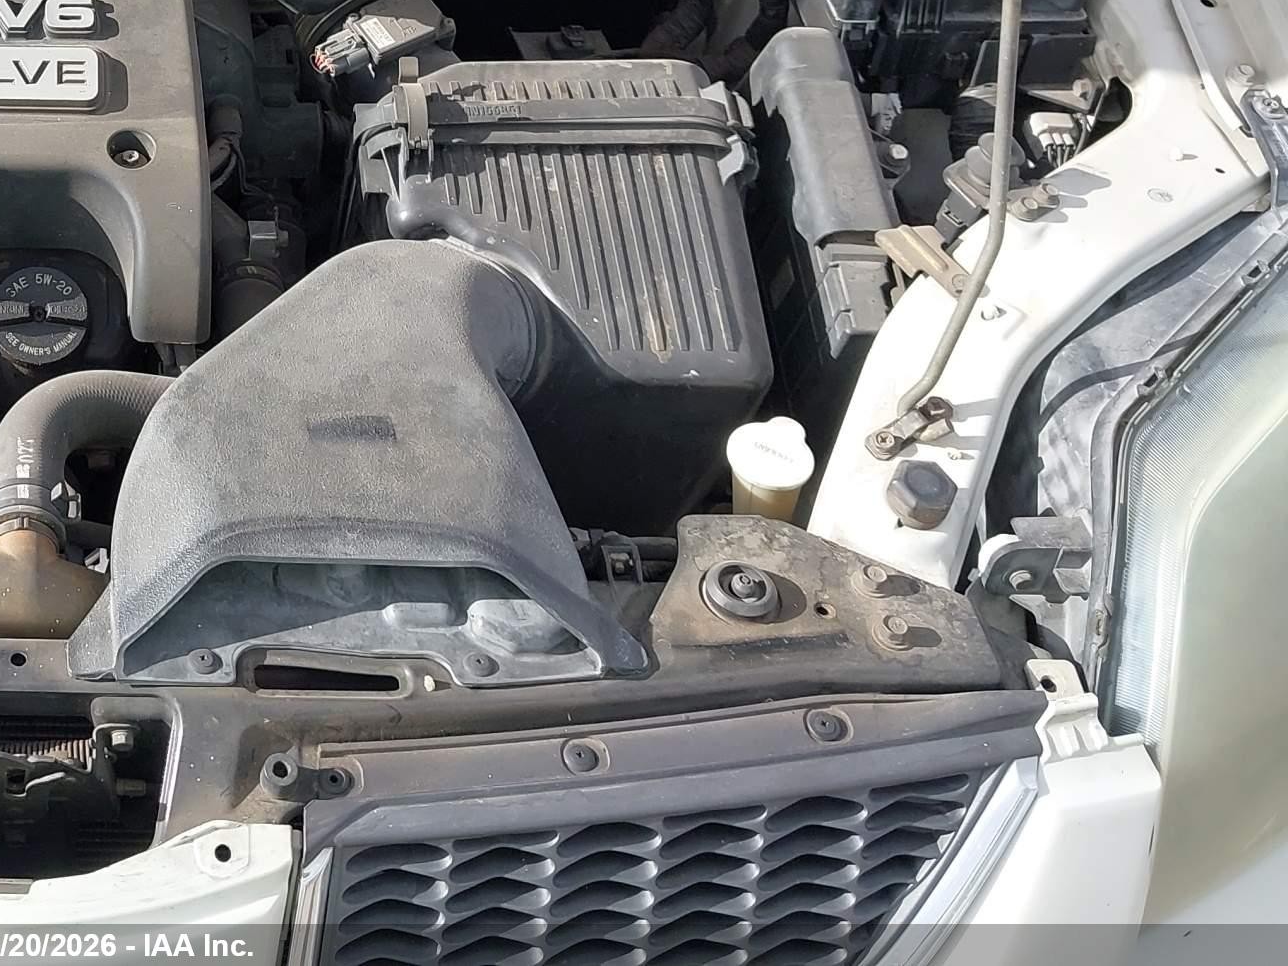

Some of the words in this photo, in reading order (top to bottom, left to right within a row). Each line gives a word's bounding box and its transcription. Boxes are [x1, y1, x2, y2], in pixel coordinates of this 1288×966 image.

[5, 277, 30, 297] SAE
[35, 273, 72, 295] 5W-20
[5, 332, 20, 347] SEE
[18, 342, 51, 355] OWNER'S
[53, 331, 77, 353] MANUAL
